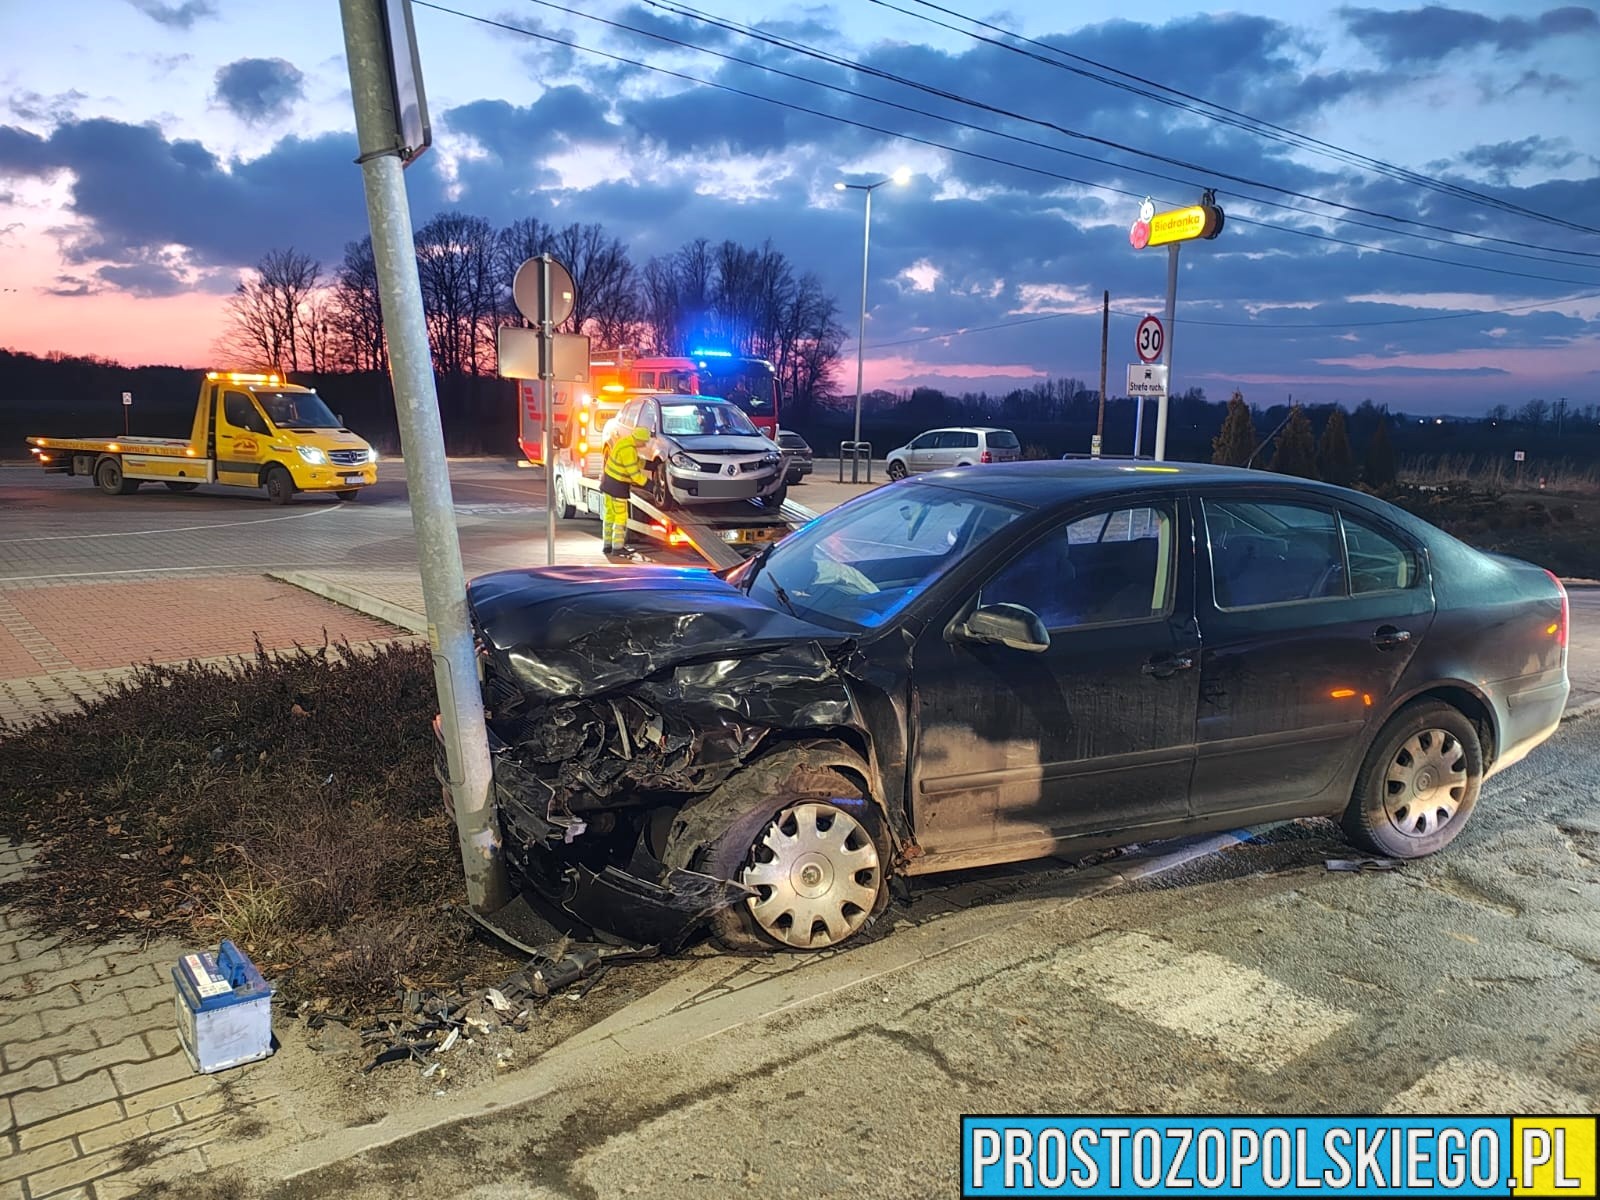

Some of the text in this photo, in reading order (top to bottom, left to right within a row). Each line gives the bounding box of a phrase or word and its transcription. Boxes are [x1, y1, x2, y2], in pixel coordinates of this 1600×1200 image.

[1154, 215, 1200, 232] Biedronka
[1141, 328, 1160, 351] 30
[1130, 381, 1148, 391] Strefa
